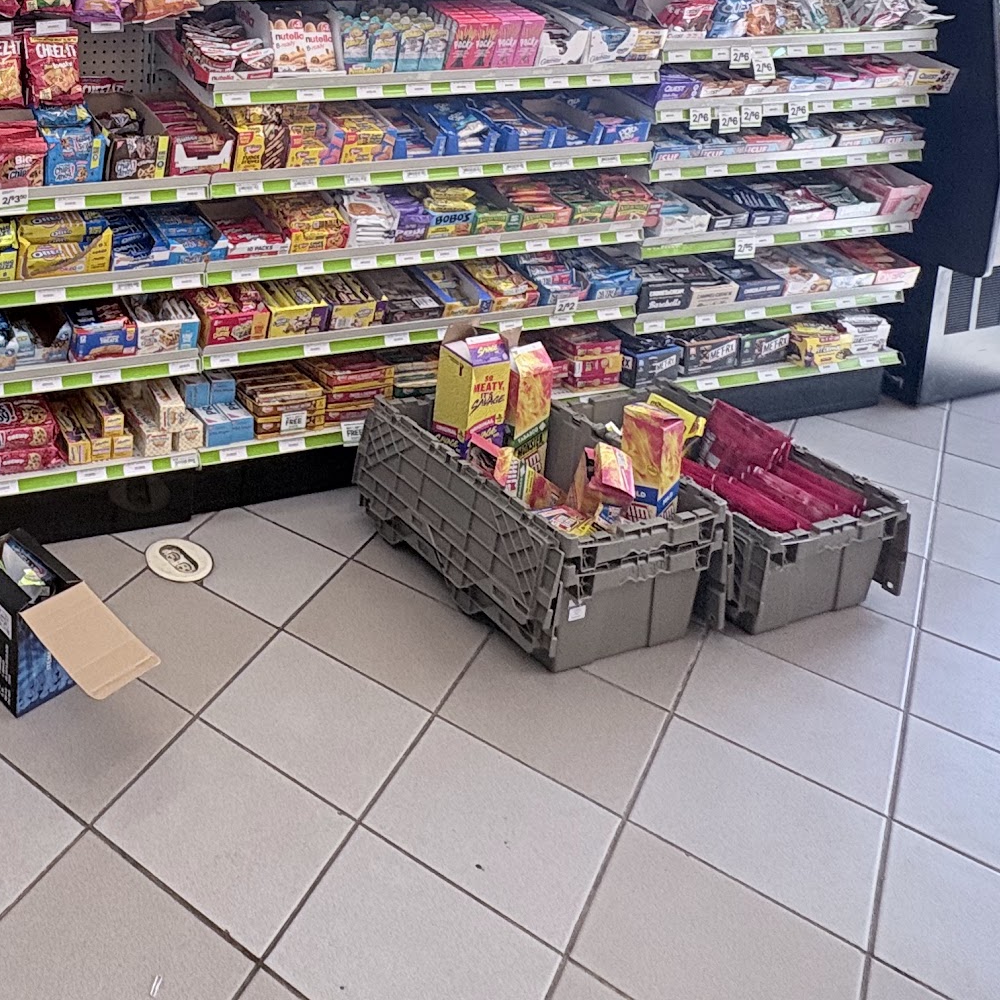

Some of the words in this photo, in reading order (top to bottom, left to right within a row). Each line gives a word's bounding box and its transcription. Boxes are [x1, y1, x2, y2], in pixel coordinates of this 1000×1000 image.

[275, 32, 303, 41] nutella
[306, 34, 332, 43] nutella
[35, 42, 78, 59] CHEEZ-IT
[435, 213, 470, 226] BOBO'S
[474, 381, 505, 393] MEATY,
[285, 417, 303, 426] FREE
